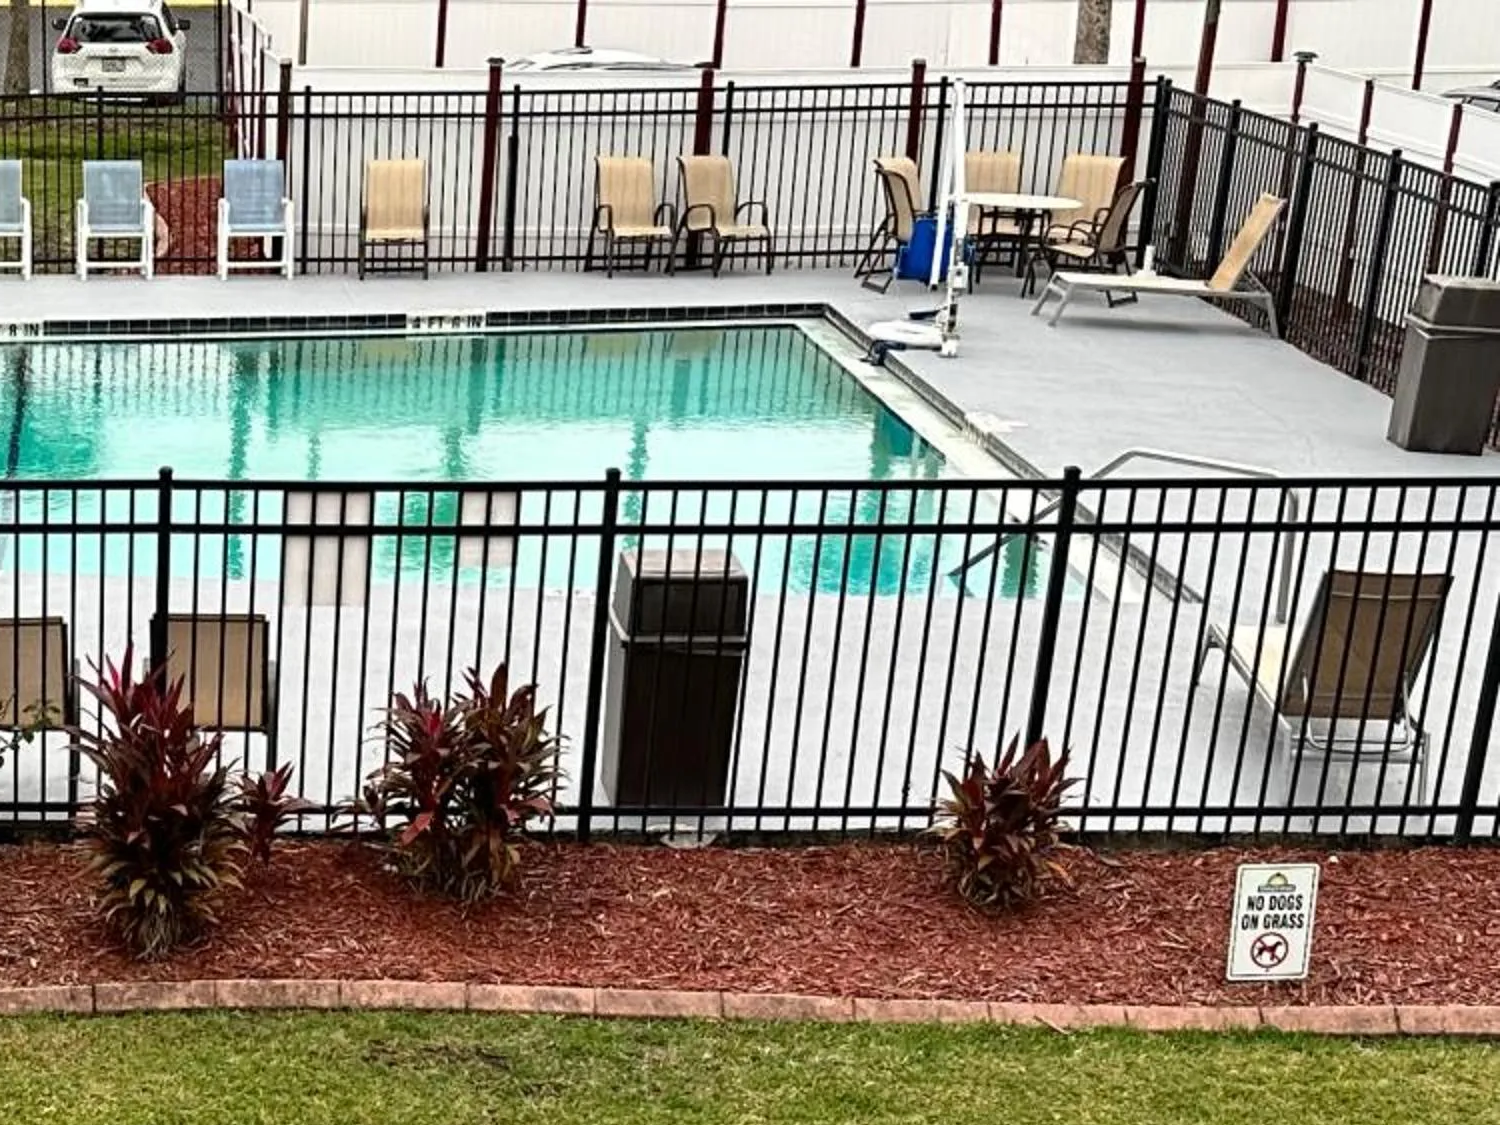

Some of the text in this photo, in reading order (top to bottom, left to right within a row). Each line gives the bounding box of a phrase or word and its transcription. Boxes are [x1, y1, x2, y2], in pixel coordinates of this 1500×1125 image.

[427, 315, 445, 329] FT
[23, 323, 39, 337] IN
[1246, 894, 1304, 911] NO DOGS
[1241, 913, 1305, 930] ON GRASS
